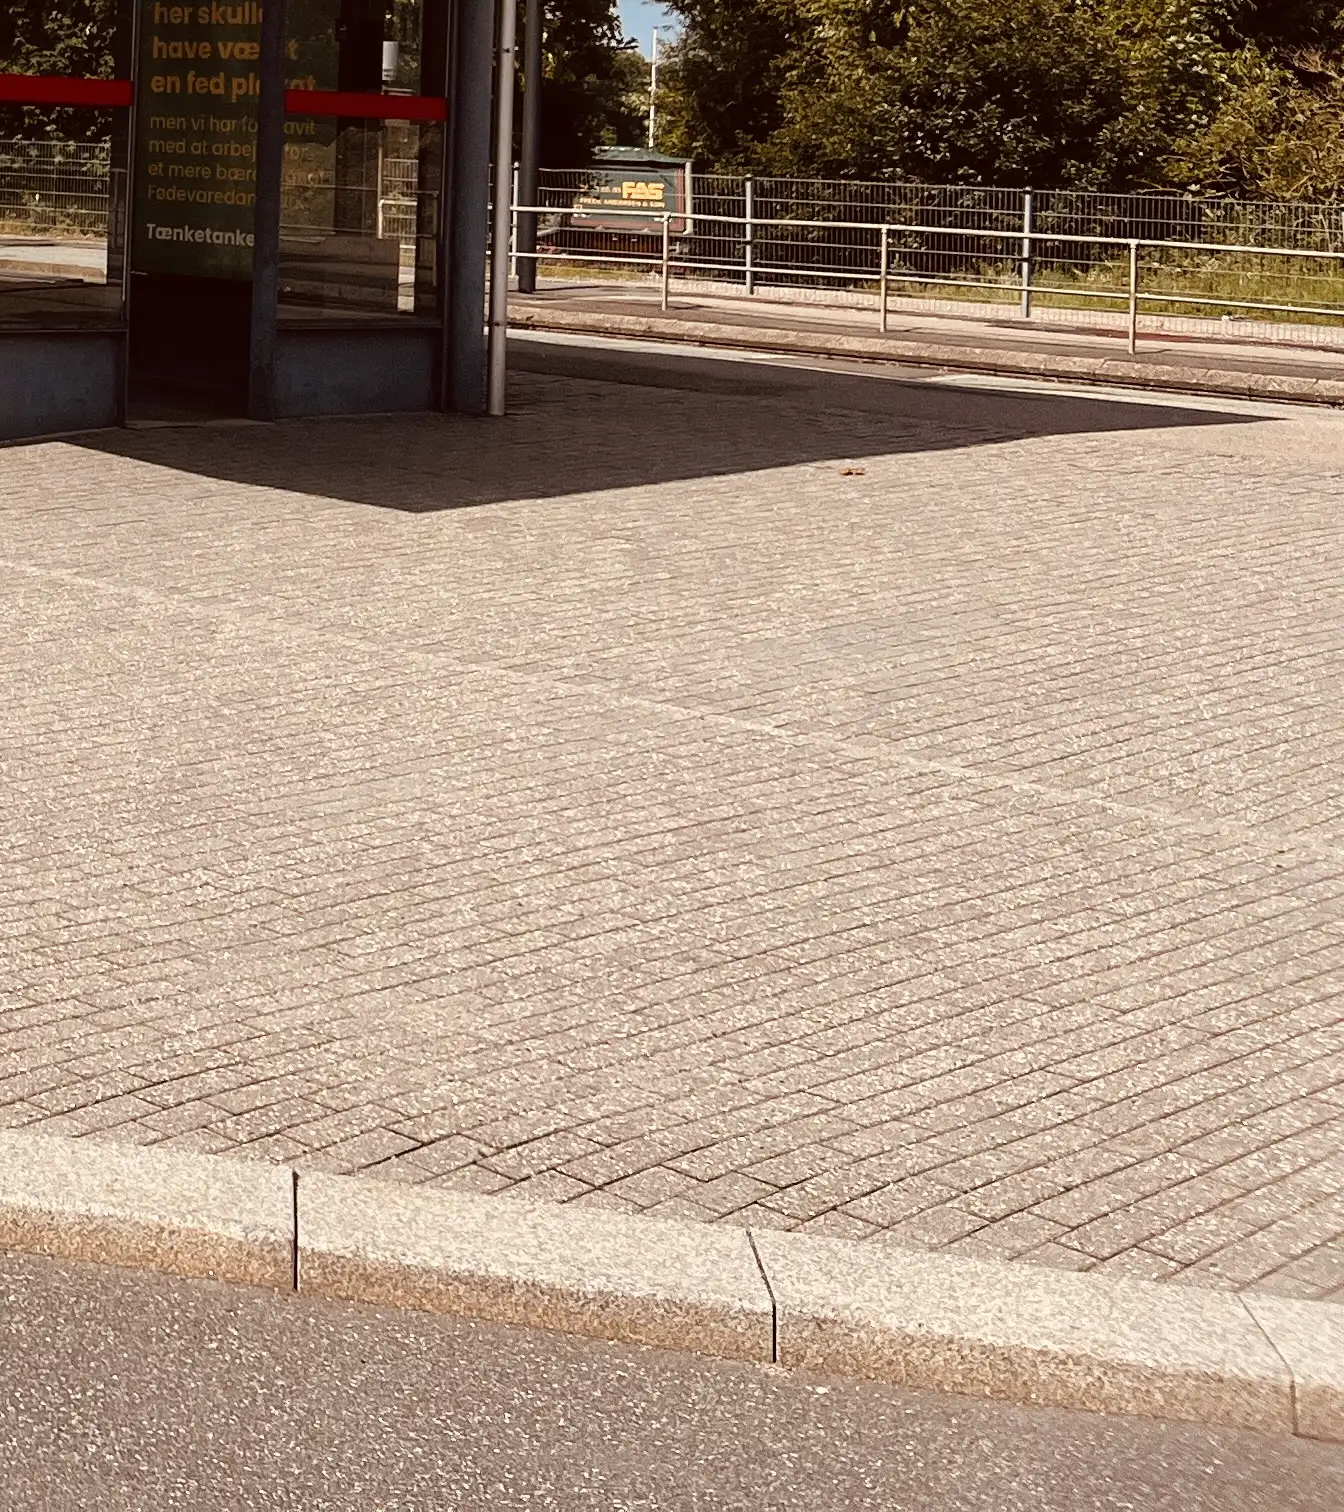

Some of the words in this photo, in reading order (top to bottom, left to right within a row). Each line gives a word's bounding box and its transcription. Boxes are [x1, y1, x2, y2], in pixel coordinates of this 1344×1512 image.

[152, 0, 193, 25] her
[196, 0, 264, 25] skull
[152, 35, 212, 59] have
[150, 74, 181, 94] en
[186, 70, 225, 95] fed
[149, 116, 186, 130] men
[191, 115, 205, 131] vi
[209, 116, 237, 132] har
[241, 115, 259, 132] fo
[148, 137, 186, 153] med
[190, 139, 208, 155] at
[212, 140, 257, 162] arbej
[148, 160, 164, 176] et
[168, 165, 212, 179] mere
[621, 181, 665, 200] FAS
[146, 223, 255, 247] Tænketanke
